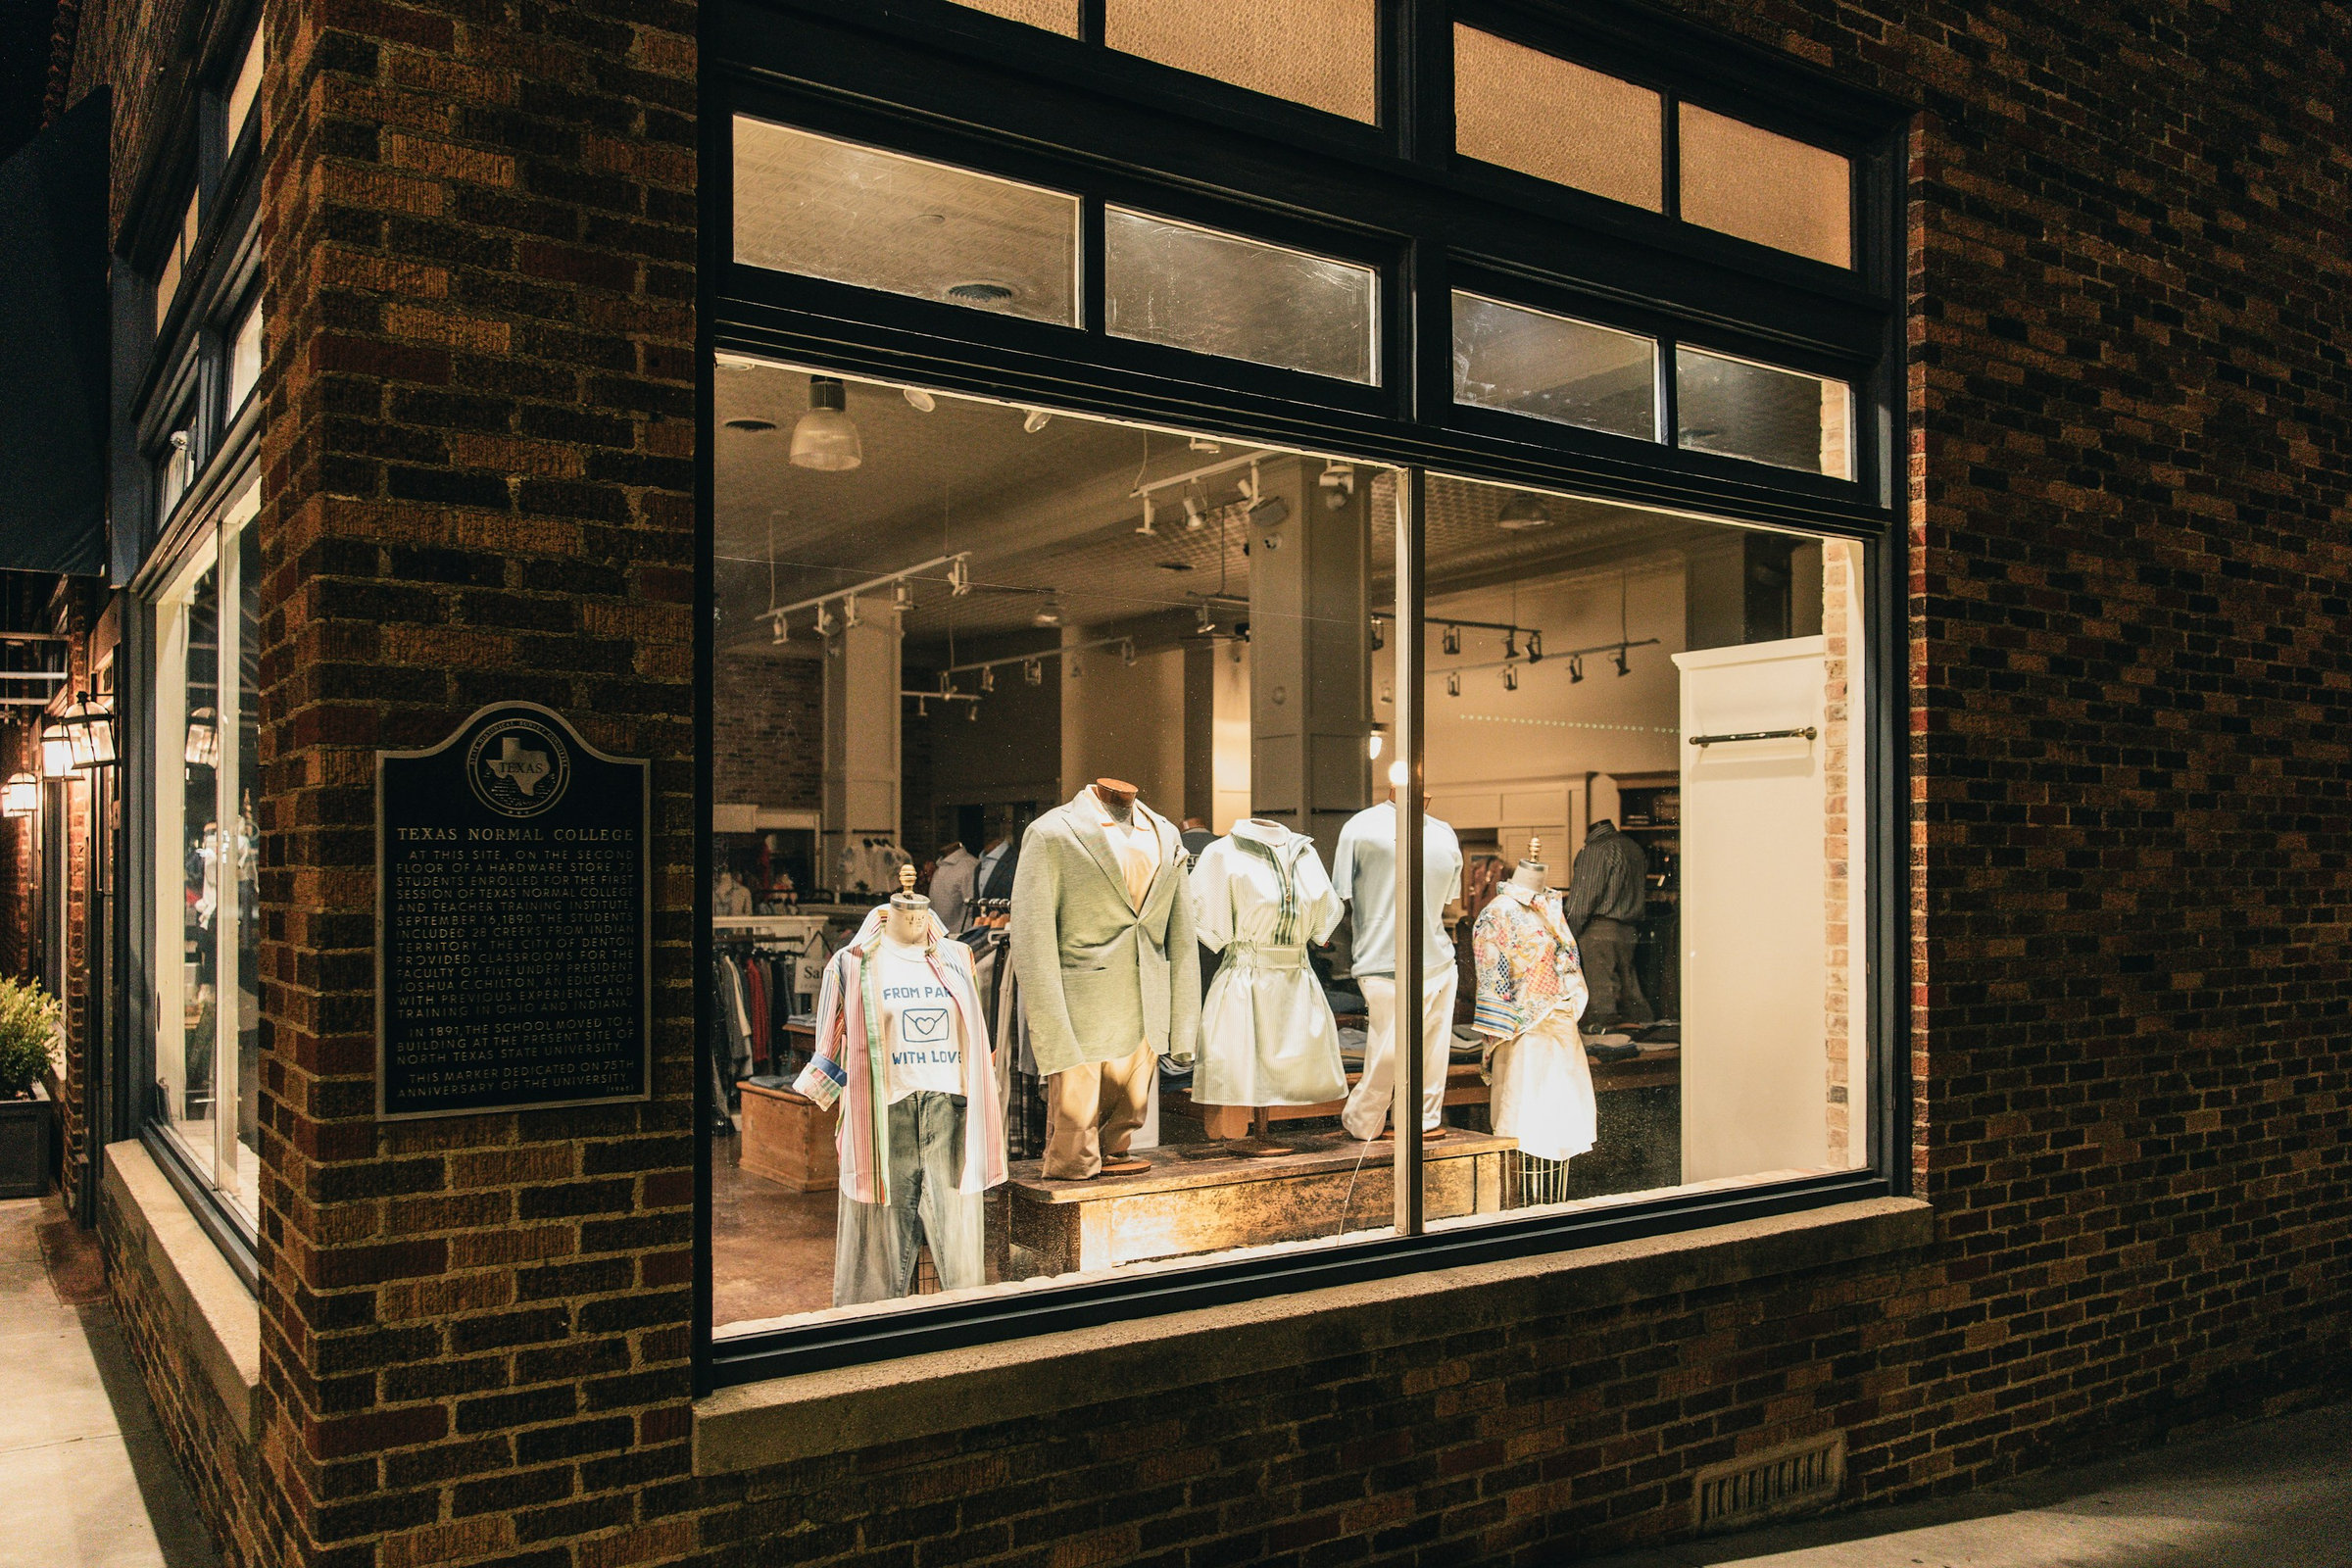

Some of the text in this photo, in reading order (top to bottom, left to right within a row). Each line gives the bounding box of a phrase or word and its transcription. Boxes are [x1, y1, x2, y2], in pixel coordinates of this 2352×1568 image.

[501, 761, 543, 773] TEXAS
[399, 827, 633, 841] TEXAS NORMAL COLLEGE
[409, 850, 425, 859] AT
[434, 850, 464, 859] THIS
[515, 850, 536, 859] ON
[544, 850, 567, 859] THE
[577, 850, 633, 859] SECOND
[397, 862, 443, 872] FLOOR
[452, 862, 469, 872] OF
[475, 862, 483, 872] A
[489, 862, 562, 872] HARDWARE
[396, 875, 634, 886] STUDENTS ENROLLED FOR THE FIRST
[396, 887, 633, 900] SESSION OF TEXAS NORMAL COLLEGE
[396, 903, 425, 912] AND
[432, 902, 492, 912] TEACHER
[501, 901, 562, 910] TRAINING
[396, 914, 475, 926] SEPTEMBER
[541, 913, 563, 923] THE
[570, 912, 633, 922] STUDENTS
[396, 924, 633, 939] INCLUDED 28 CREEKS FROM INDIAN
[490, 940, 514, 950] THE
[521, 939, 549, 949] CITY
[557, 938, 574, 949] OF
[582, 937, 633, 948] DENTON
[397, 949, 633, 965] PROVIDED CLASSROOMS FOR THE
[397, 961, 633, 979] FACULTY OF FIVE UNDER PRESIDENT
[804, 966, 824, 979] Sal
[397, 980, 454, 992] JOSHUA
[544, 976, 562, 987] AN
[566, 974, 633, 986] EDUCATOR
[397, 987, 633, 1005] WITH PREVIOUS EXPERIENCE AND
[883, 986, 953, 1001] FROM PAR
[397, 1005, 467, 1018] TRAINING
[476, 1004, 490, 1014] IN
[497, 1004, 534, 1013] OHIO
[541, 1002, 566, 1011] AND
[410, 1026, 423, 1037] IN
[465, 1023, 489, 1034] THE
[495, 1020, 551, 1033] SCHOOL
[556, 1018, 602, 1030] MOVED
[607, 1017, 622, 1027] TO
[627, 1016, 633, 1026] A
[397, 1029, 633, 1051] BUILDING AT THE PRESENT SITE OF
[397, 1052, 445, 1064] NORTH
[453, 1050, 493, 1061] TEXAS
[501, 1047, 537, 1058] STATE
[892, 1051, 926, 1065] WITH
[410, 1059, 633, 1083] THIS MARKER DEDICATED ON 75TH
[397, 1081, 494, 1098] ANNIVERSARY
[501, 1080, 517, 1091] OF
[524, 1078, 547, 1089] THE
